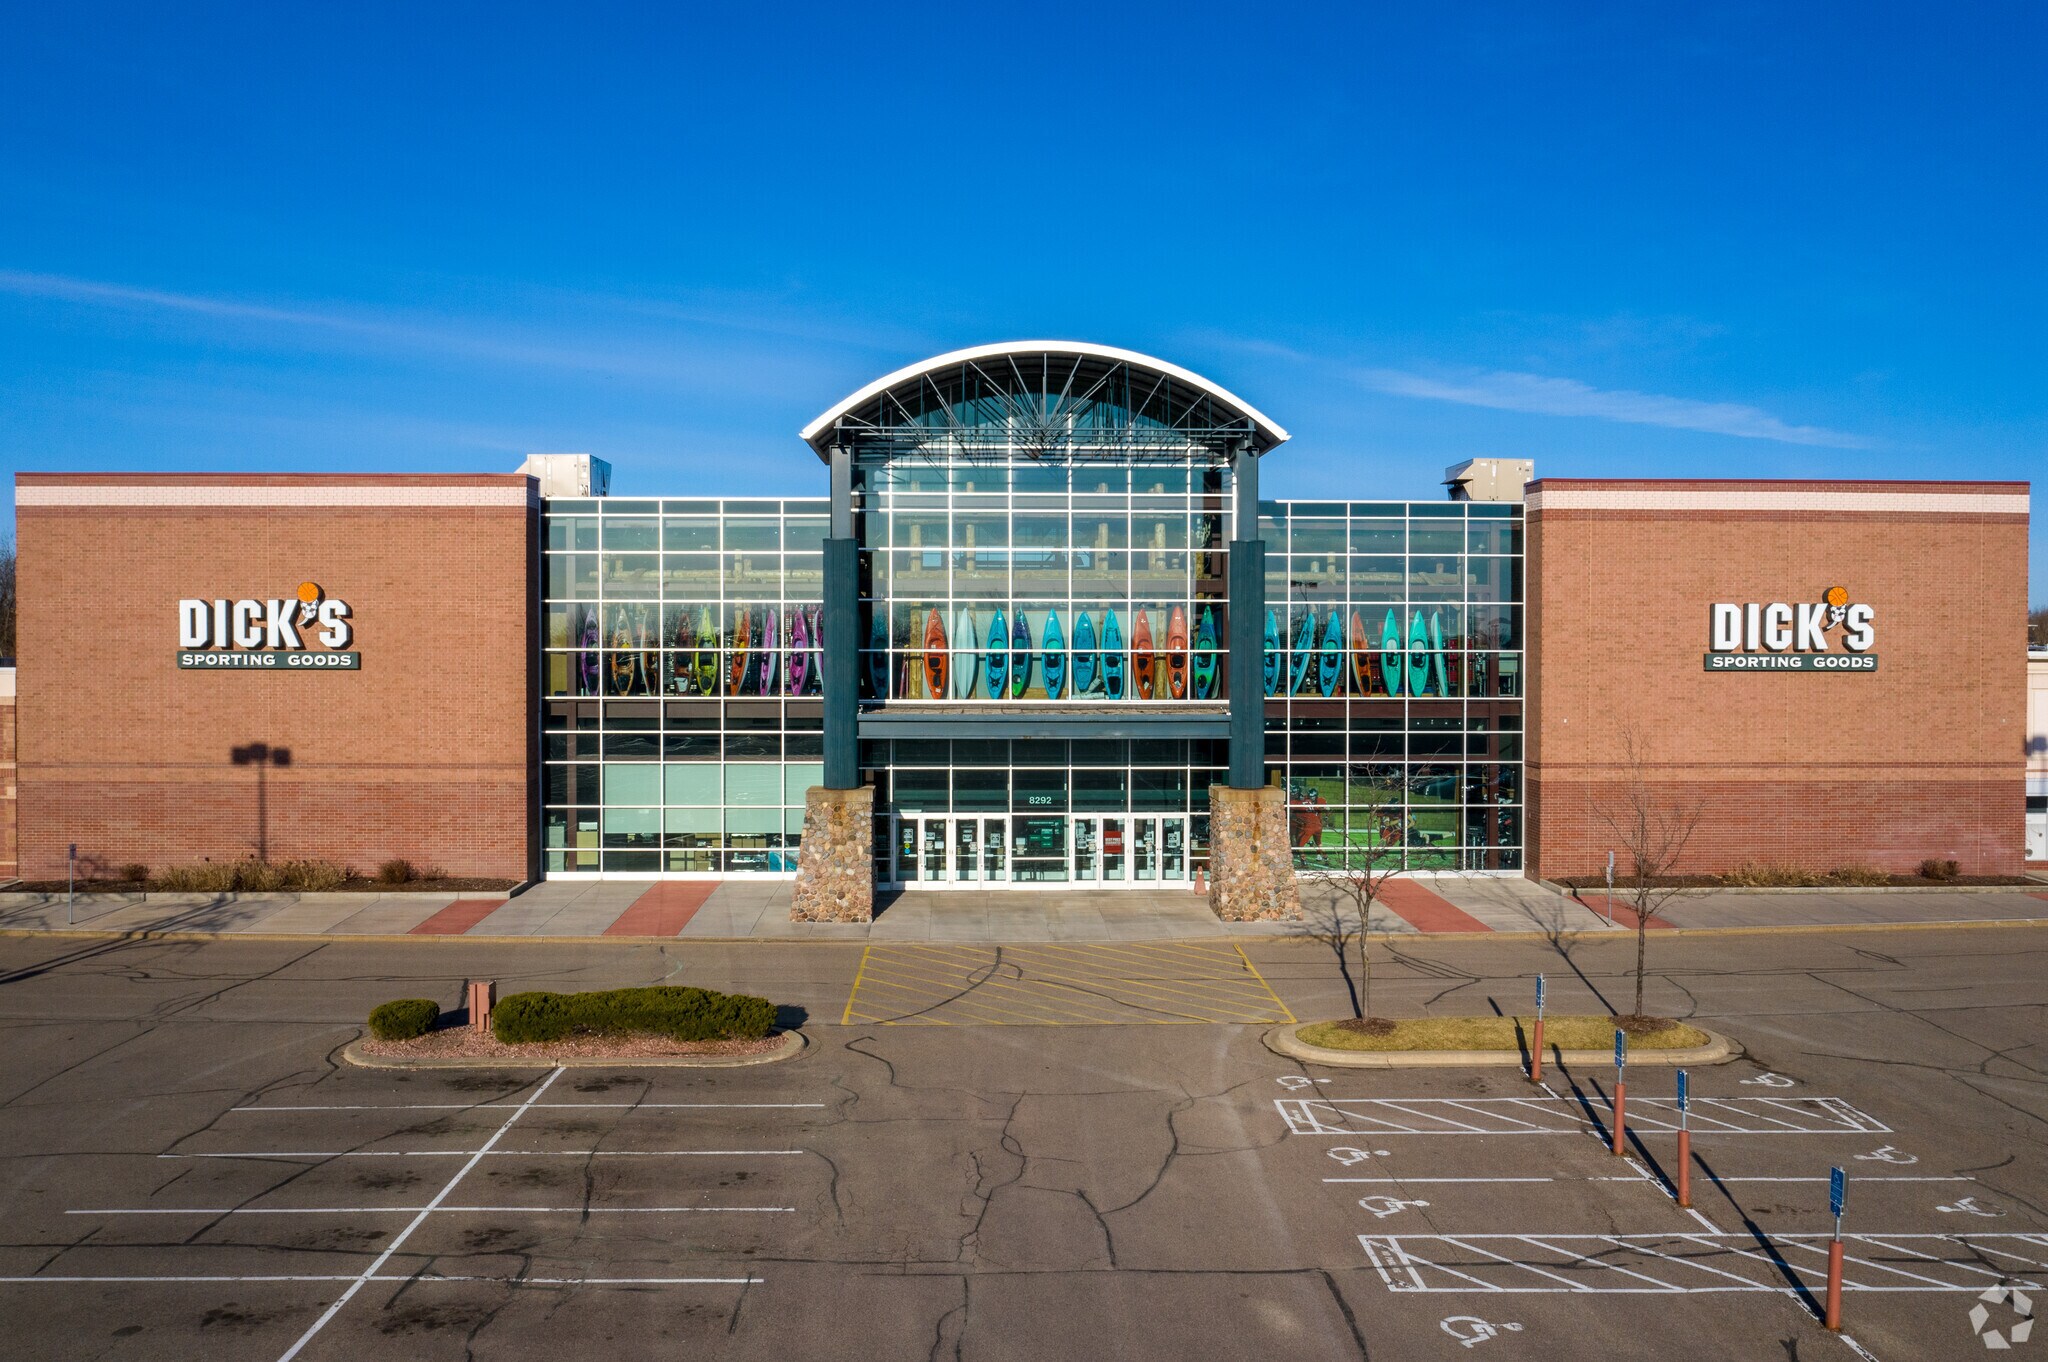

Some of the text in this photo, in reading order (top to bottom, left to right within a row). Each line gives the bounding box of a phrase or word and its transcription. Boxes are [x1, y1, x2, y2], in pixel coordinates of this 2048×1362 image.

[179, 582, 350, 648] DICK'S
[1712, 586, 1875, 651] DICK'S
[181, 653, 352, 667] SPORTING GOODS
[1712, 656, 1874, 668] SPORTING GOODS
[1029, 796, 1052, 805] 8292
